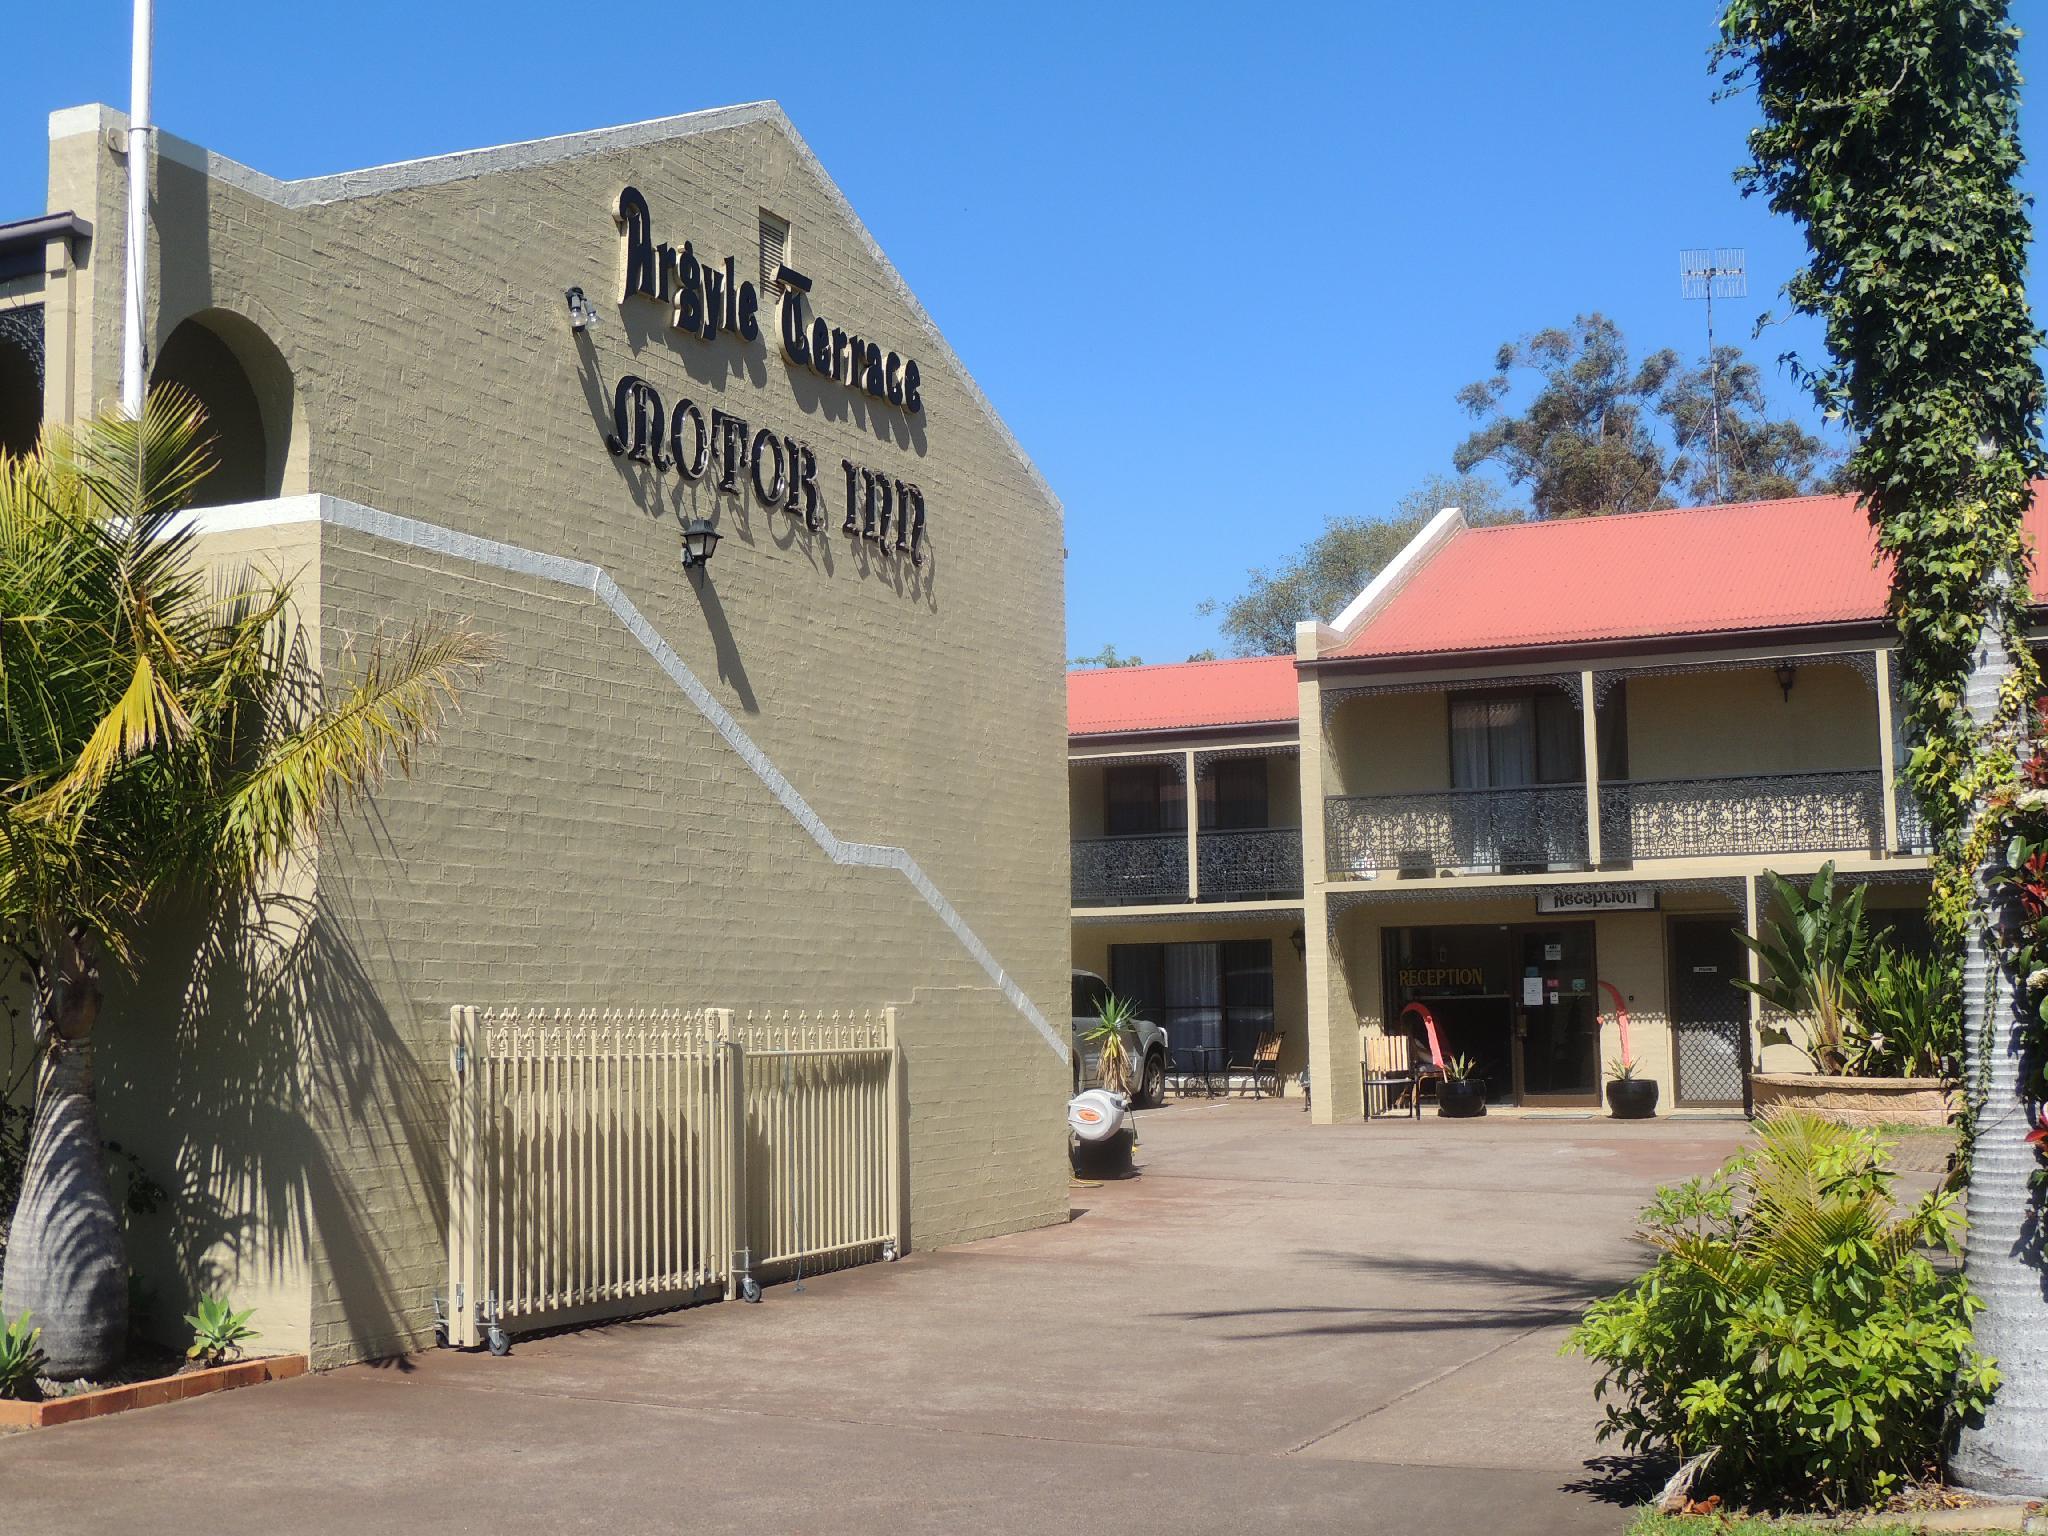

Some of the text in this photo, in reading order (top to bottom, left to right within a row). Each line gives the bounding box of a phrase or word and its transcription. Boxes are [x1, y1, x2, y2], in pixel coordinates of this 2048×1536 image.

[614, 186, 921, 414] Argyle Terrace
[608, 375, 826, 532] MOTOR
[1554, 889, 1637, 909] Reception
[1399, 967, 1483, 987] RECEPTION
